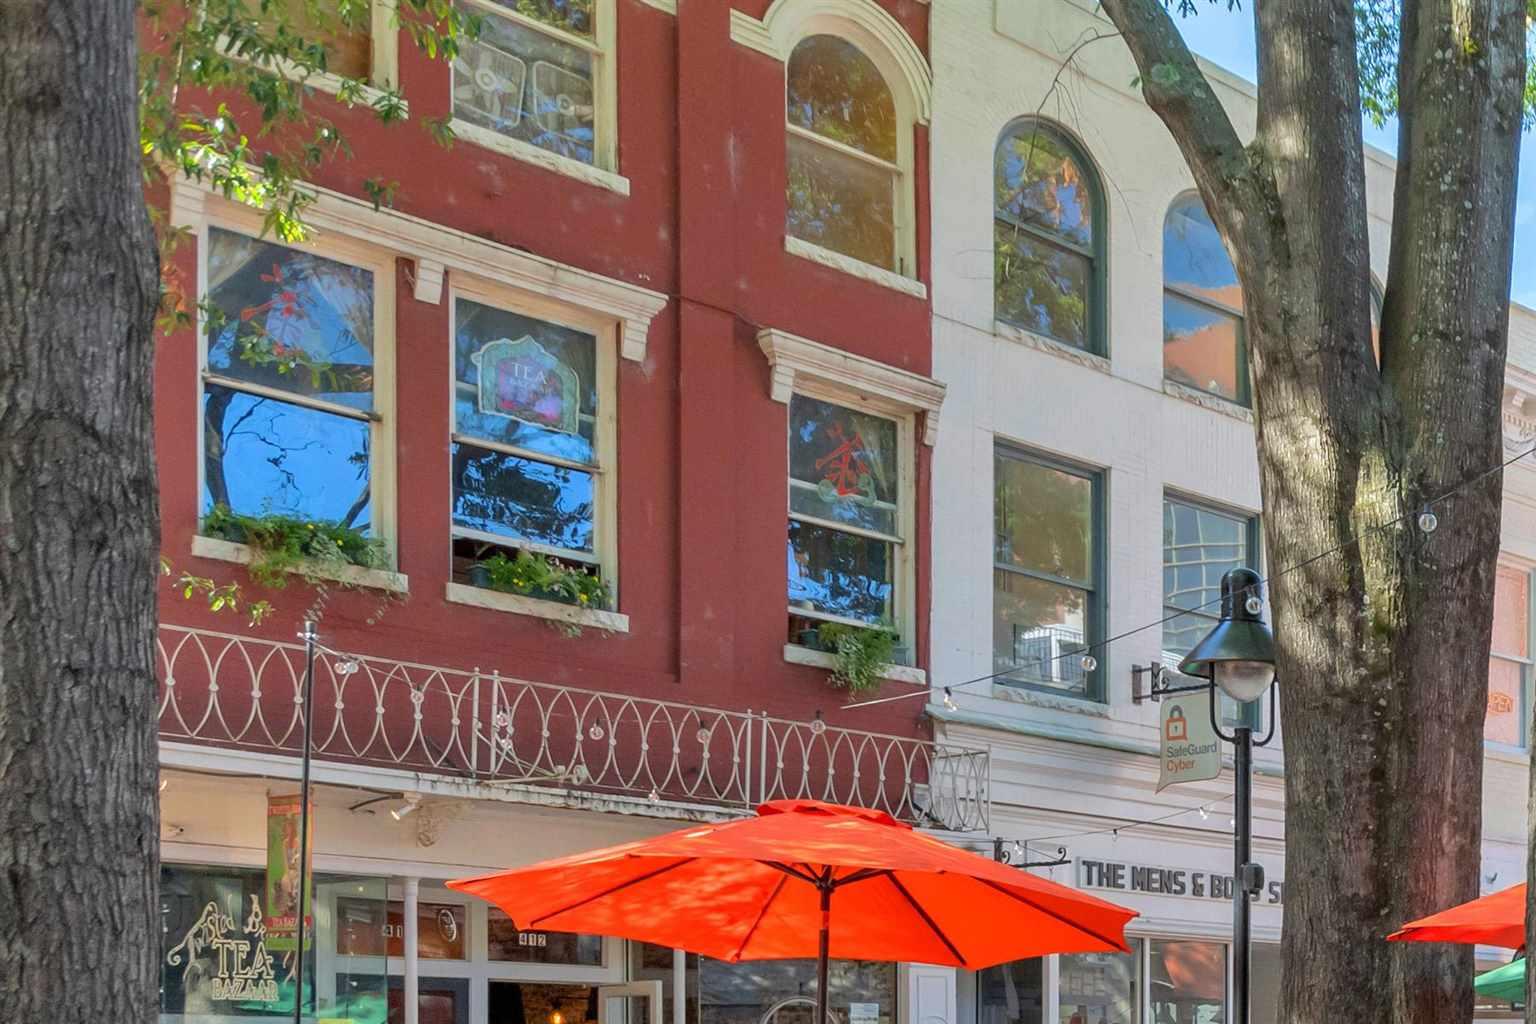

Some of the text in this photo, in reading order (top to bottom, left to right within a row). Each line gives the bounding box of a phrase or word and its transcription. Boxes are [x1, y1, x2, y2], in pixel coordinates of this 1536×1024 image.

[511, 362, 547, 385] TEA
[1167, 741, 1218, 758] SafeGuard
[1167, 758, 1194, 773] Cyber
[1082, 860, 1125, 889] THE
[1131, 865, 1186, 895] MENS
[1192, 872, 1204, 897] &
[1210, 874, 1261, 902] BO
[519, 932, 547, 947] 412
[212, 939, 275, 979] TEA
[212, 978, 279, 1000] BAZAAR
